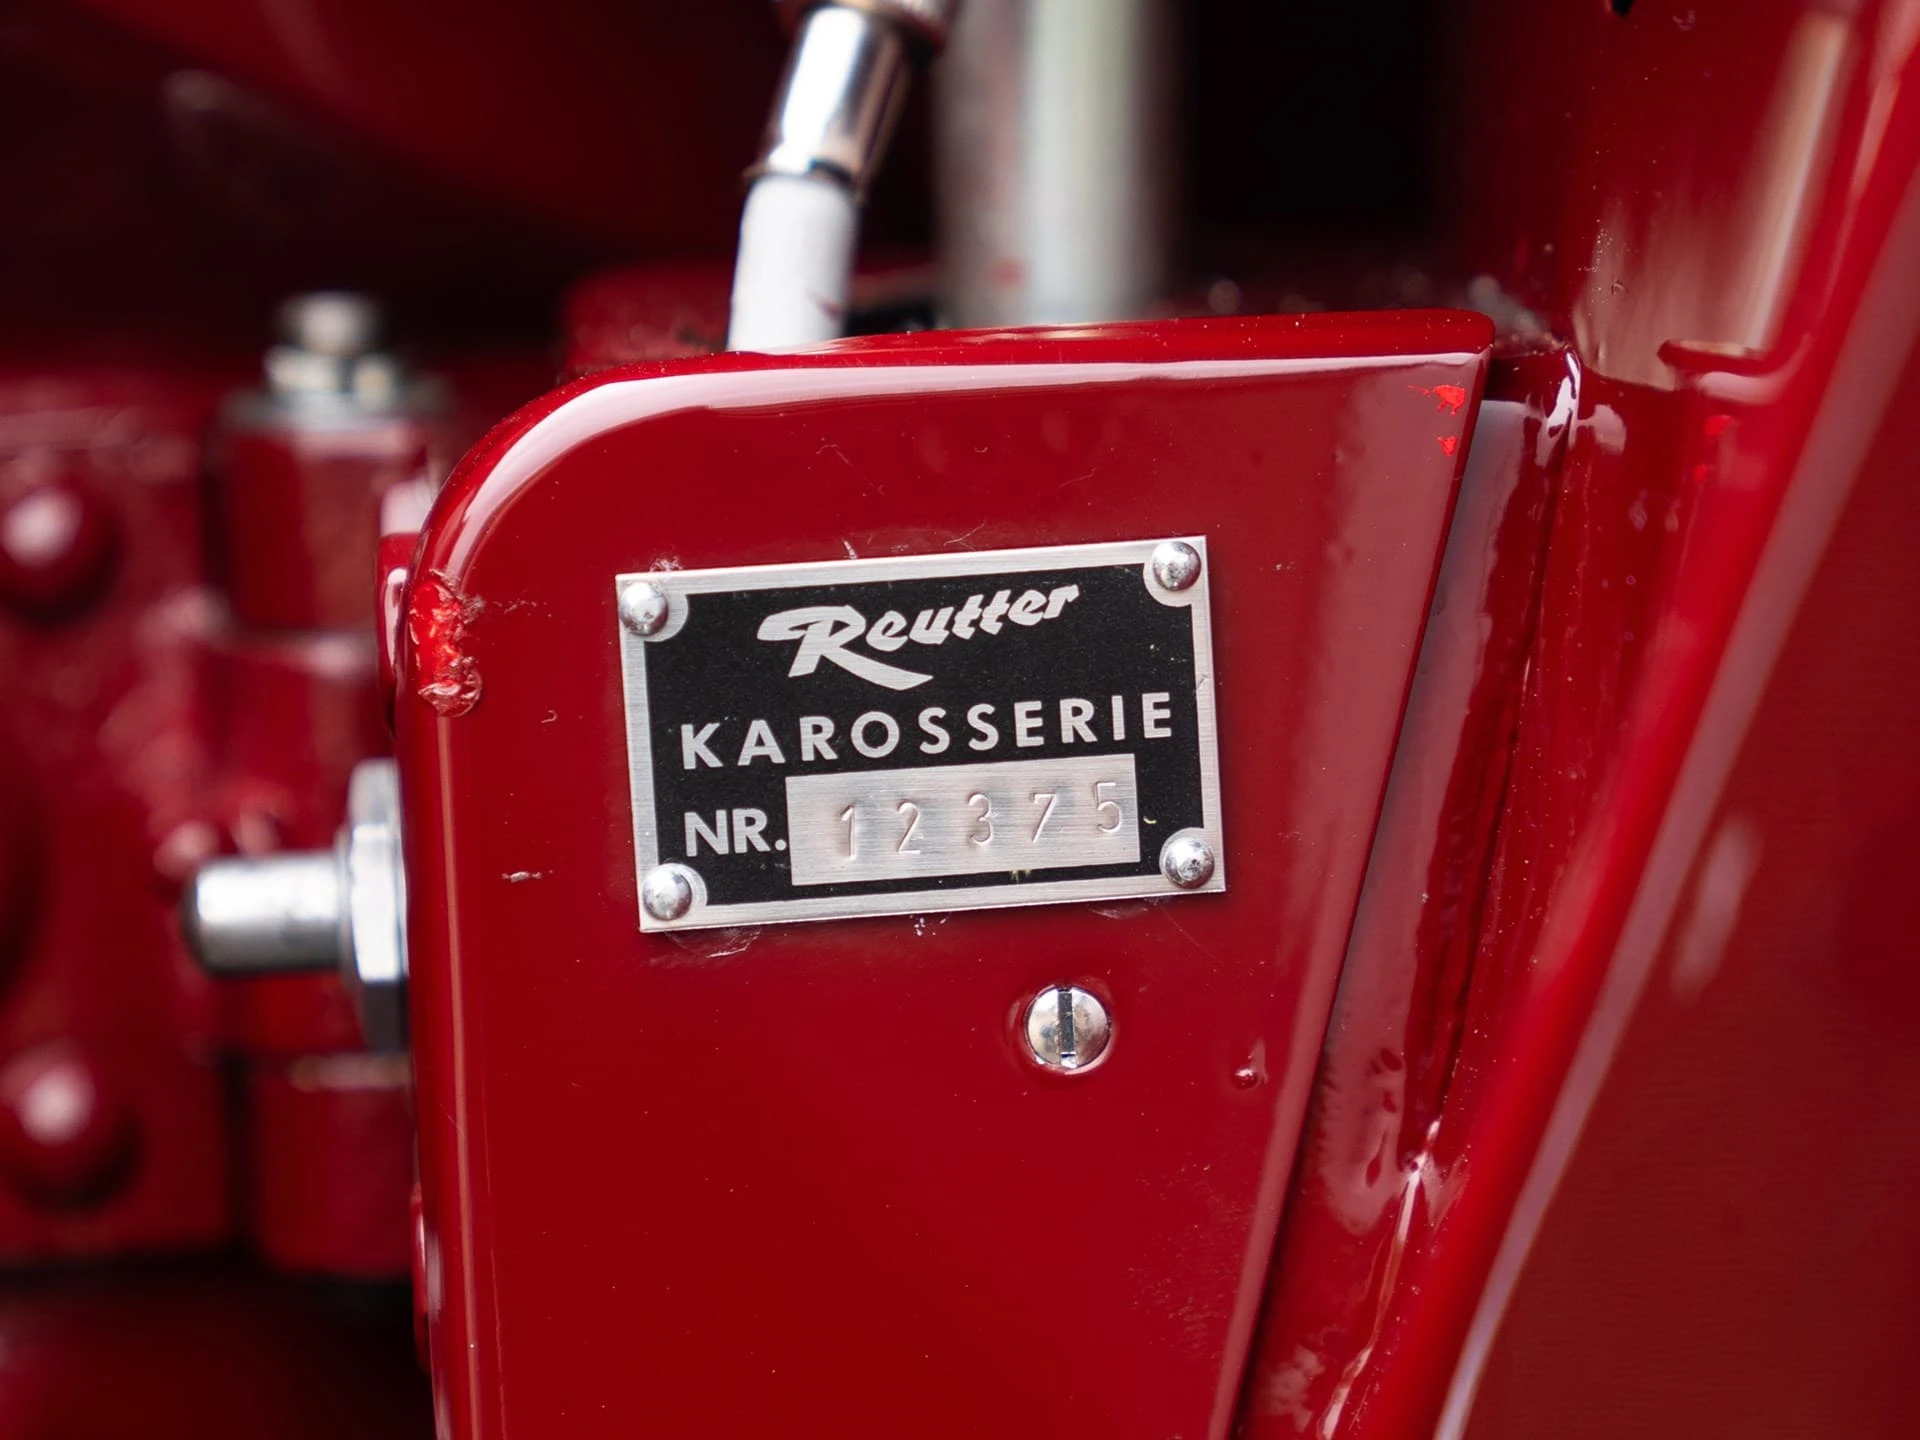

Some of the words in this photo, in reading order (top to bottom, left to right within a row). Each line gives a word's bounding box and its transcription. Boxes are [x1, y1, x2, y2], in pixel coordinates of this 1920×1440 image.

[756, 584, 1080, 691] Reutter
[681, 692, 1173, 770] KAROSSERIE
[684, 807, 787, 857] NR.
[839, 781, 1123, 861] 12375
